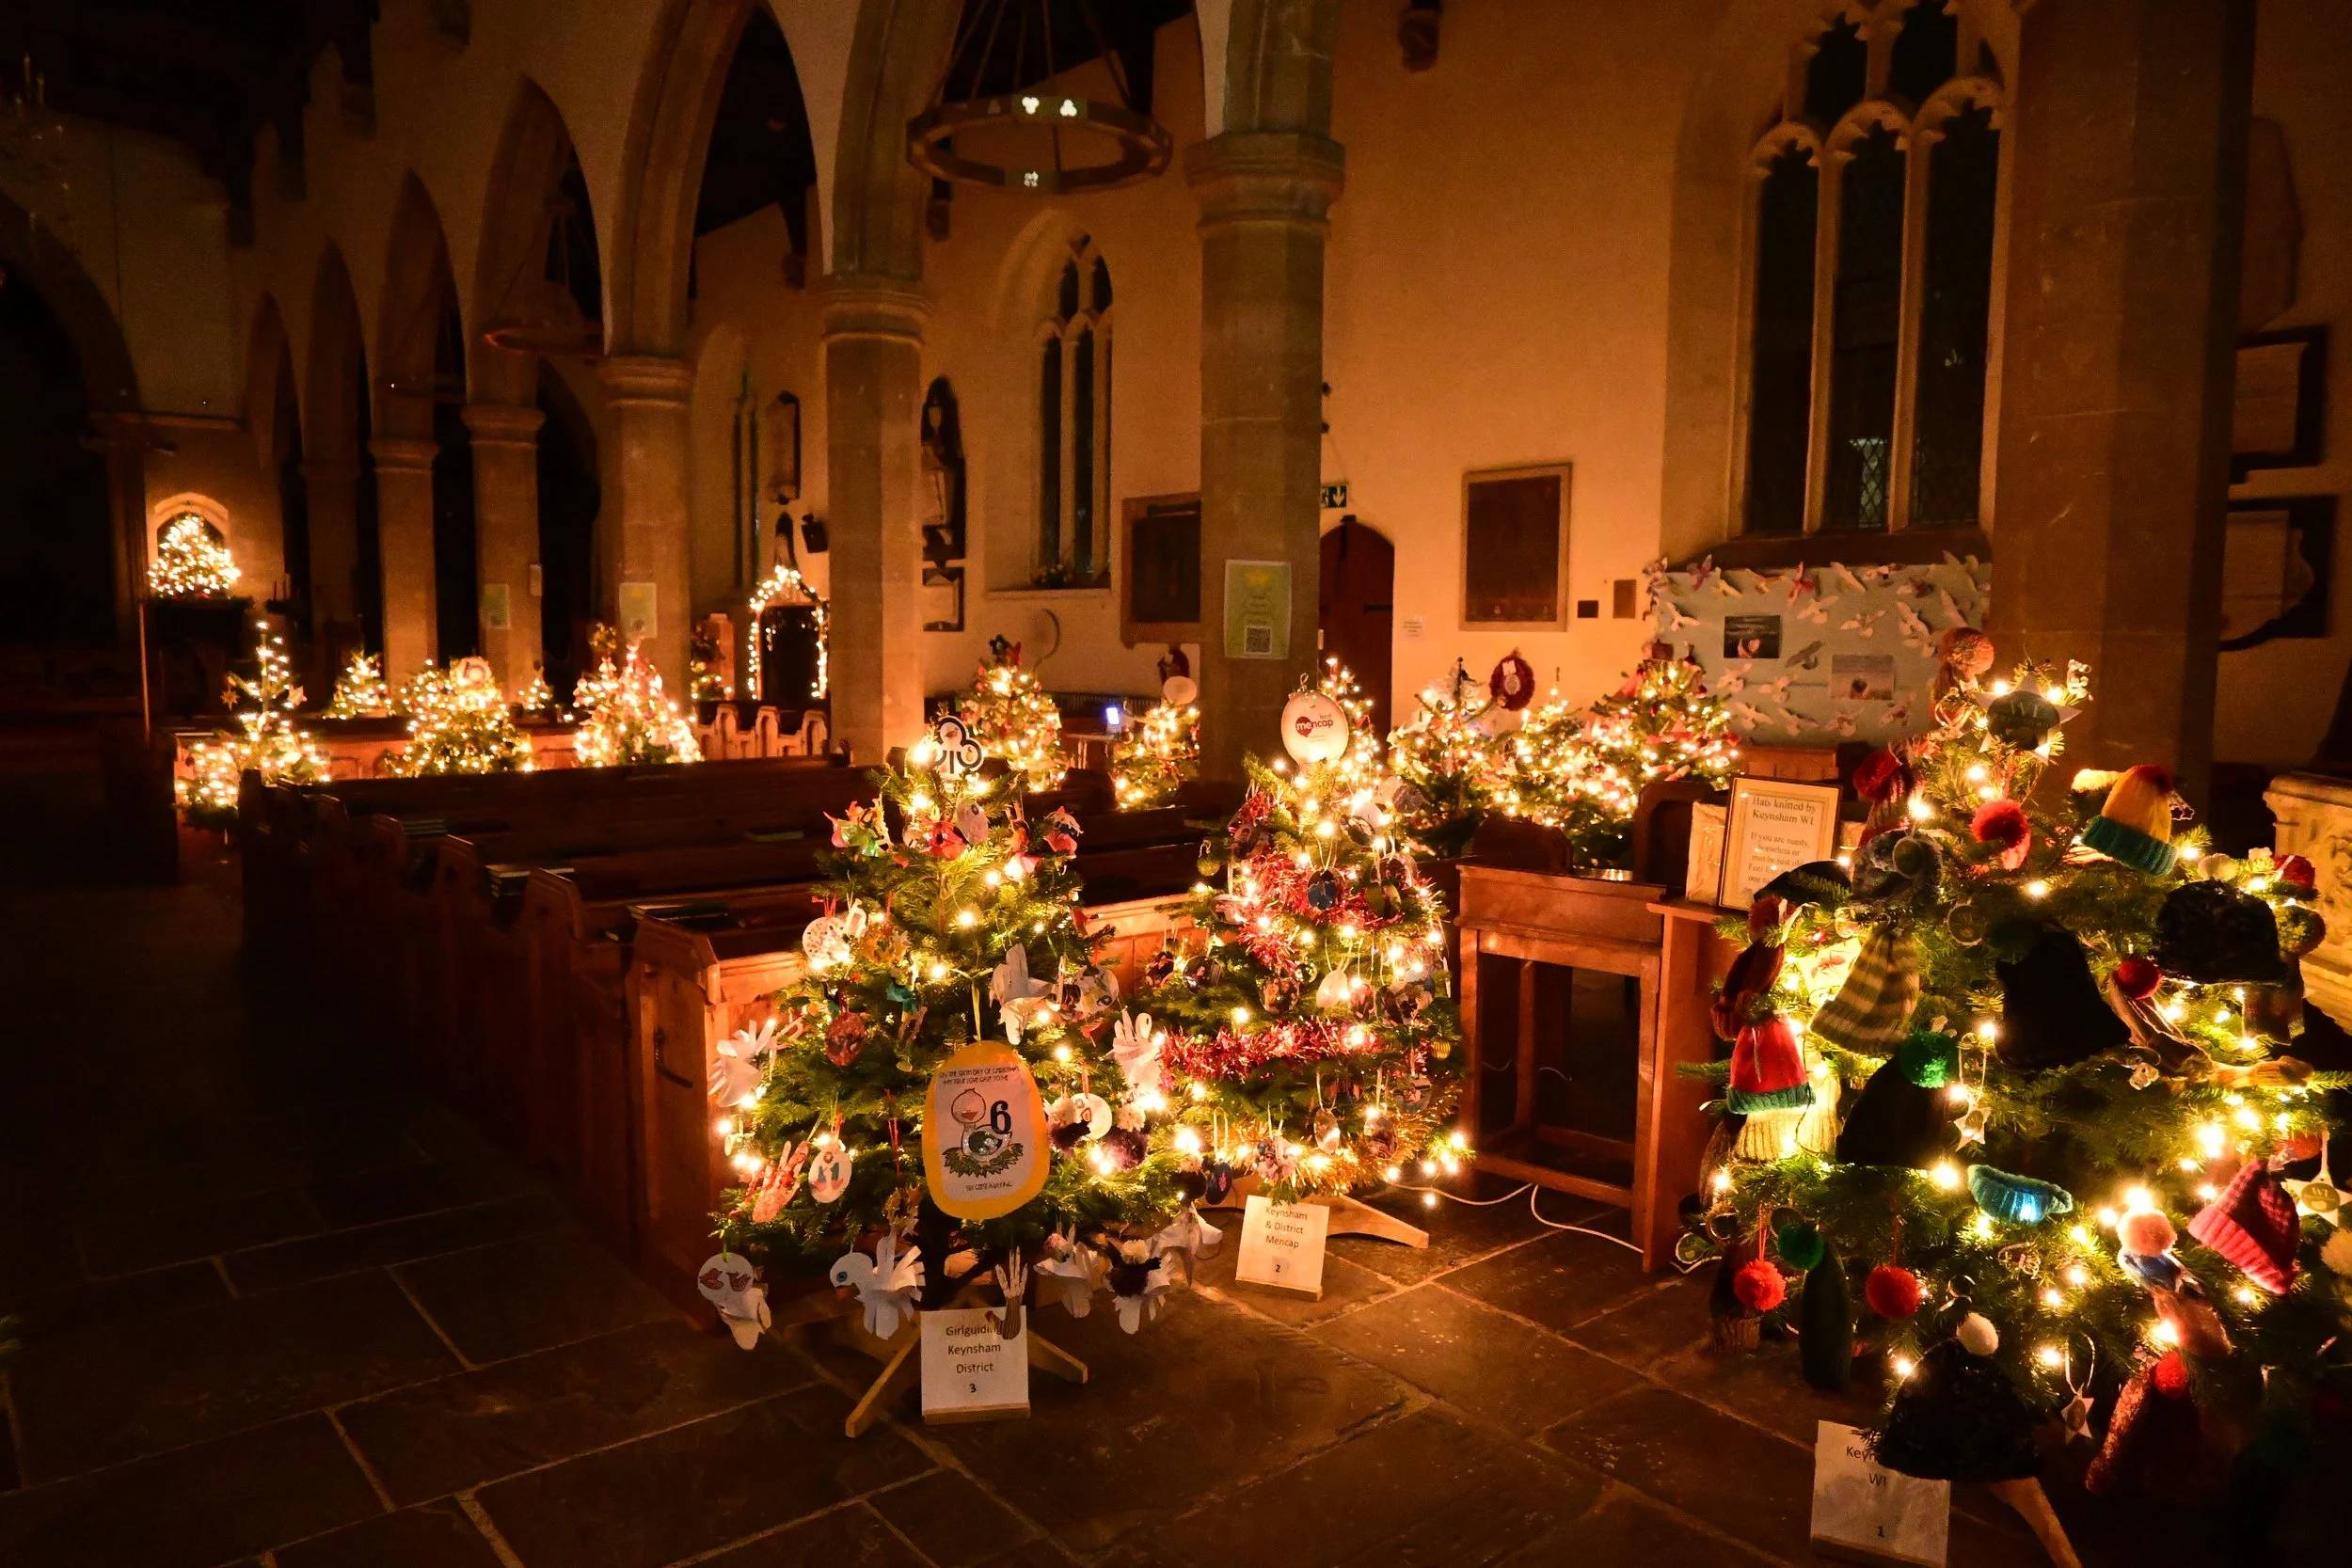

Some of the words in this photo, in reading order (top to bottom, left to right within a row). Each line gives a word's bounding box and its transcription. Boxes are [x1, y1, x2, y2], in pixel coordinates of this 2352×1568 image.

[1296, 719, 1334, 731] mencap
[1753, 797, 1772, 807] Hats
[1774, 800, 1804, 811] knitted
[1806, 803, 1816, 814] by
[1753, 809, 1798, 823] Keynsham
[1801, 815, 1814, 825] WI
[1751, 832, 1757, 840] If
[990, 1100, 1011, 1134] 6
[1265, 1206, 1308, 1220] Keynsham
[1265, 1220, 1272, 1229] &
[1274, 1222, 1303, 1234] District
[1265, 1234, 1299, 1249] Mencap
[1275, 1264, 1280, 1273] 2
[947, 1342, 1001, 1356] Keynsham
[956, 1362, 994, 1374] District
[969, 1383, 977, 1393] 3
[1868, 1472, 1887, 1487] WI
[1877, 1526, 1884, 1537] 1
